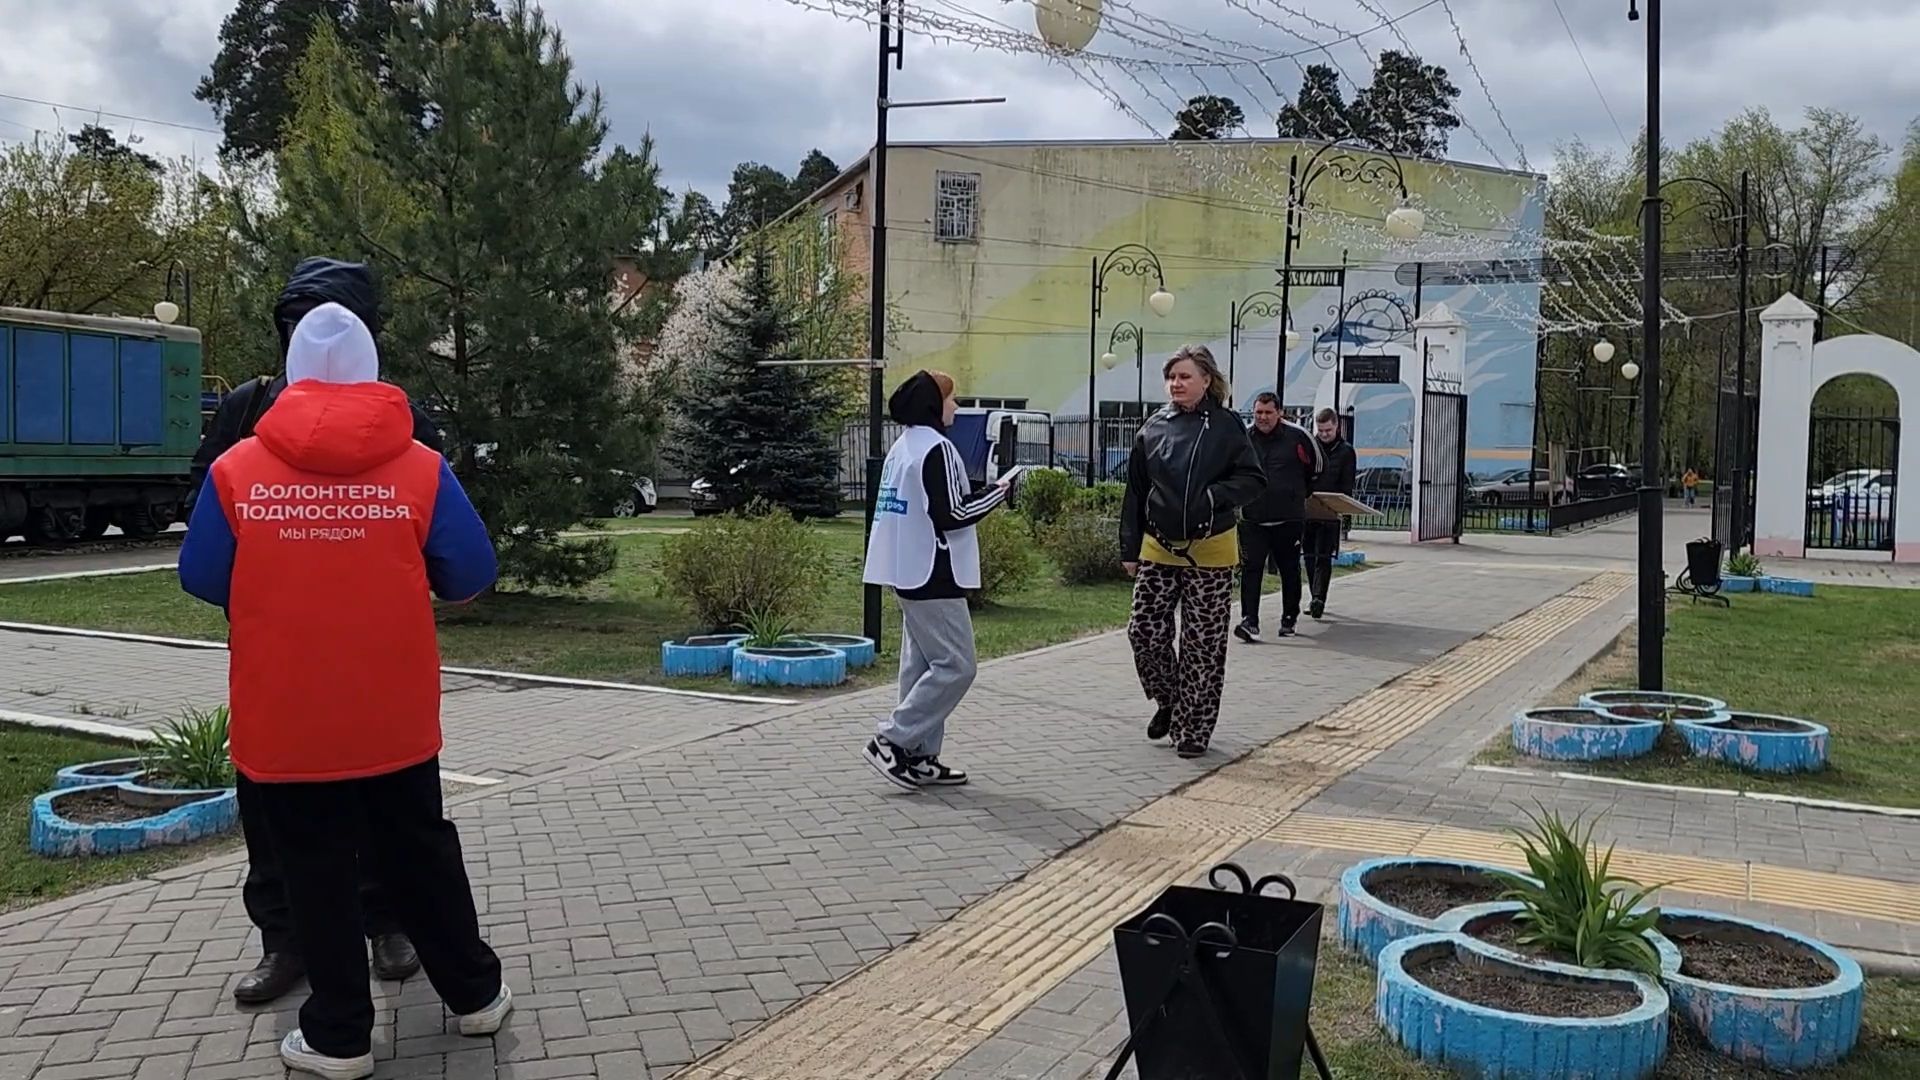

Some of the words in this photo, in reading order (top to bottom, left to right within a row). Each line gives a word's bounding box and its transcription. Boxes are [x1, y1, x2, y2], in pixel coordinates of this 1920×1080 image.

[250, 483, 395, 500] ВОЛОНТЕРЫ
[235, 503, 411, 521] ПОДМОСКОВЬЯ
[279, 527, 306, 540] МЫ
[310, 527, 366, 541] РЯДОМ
